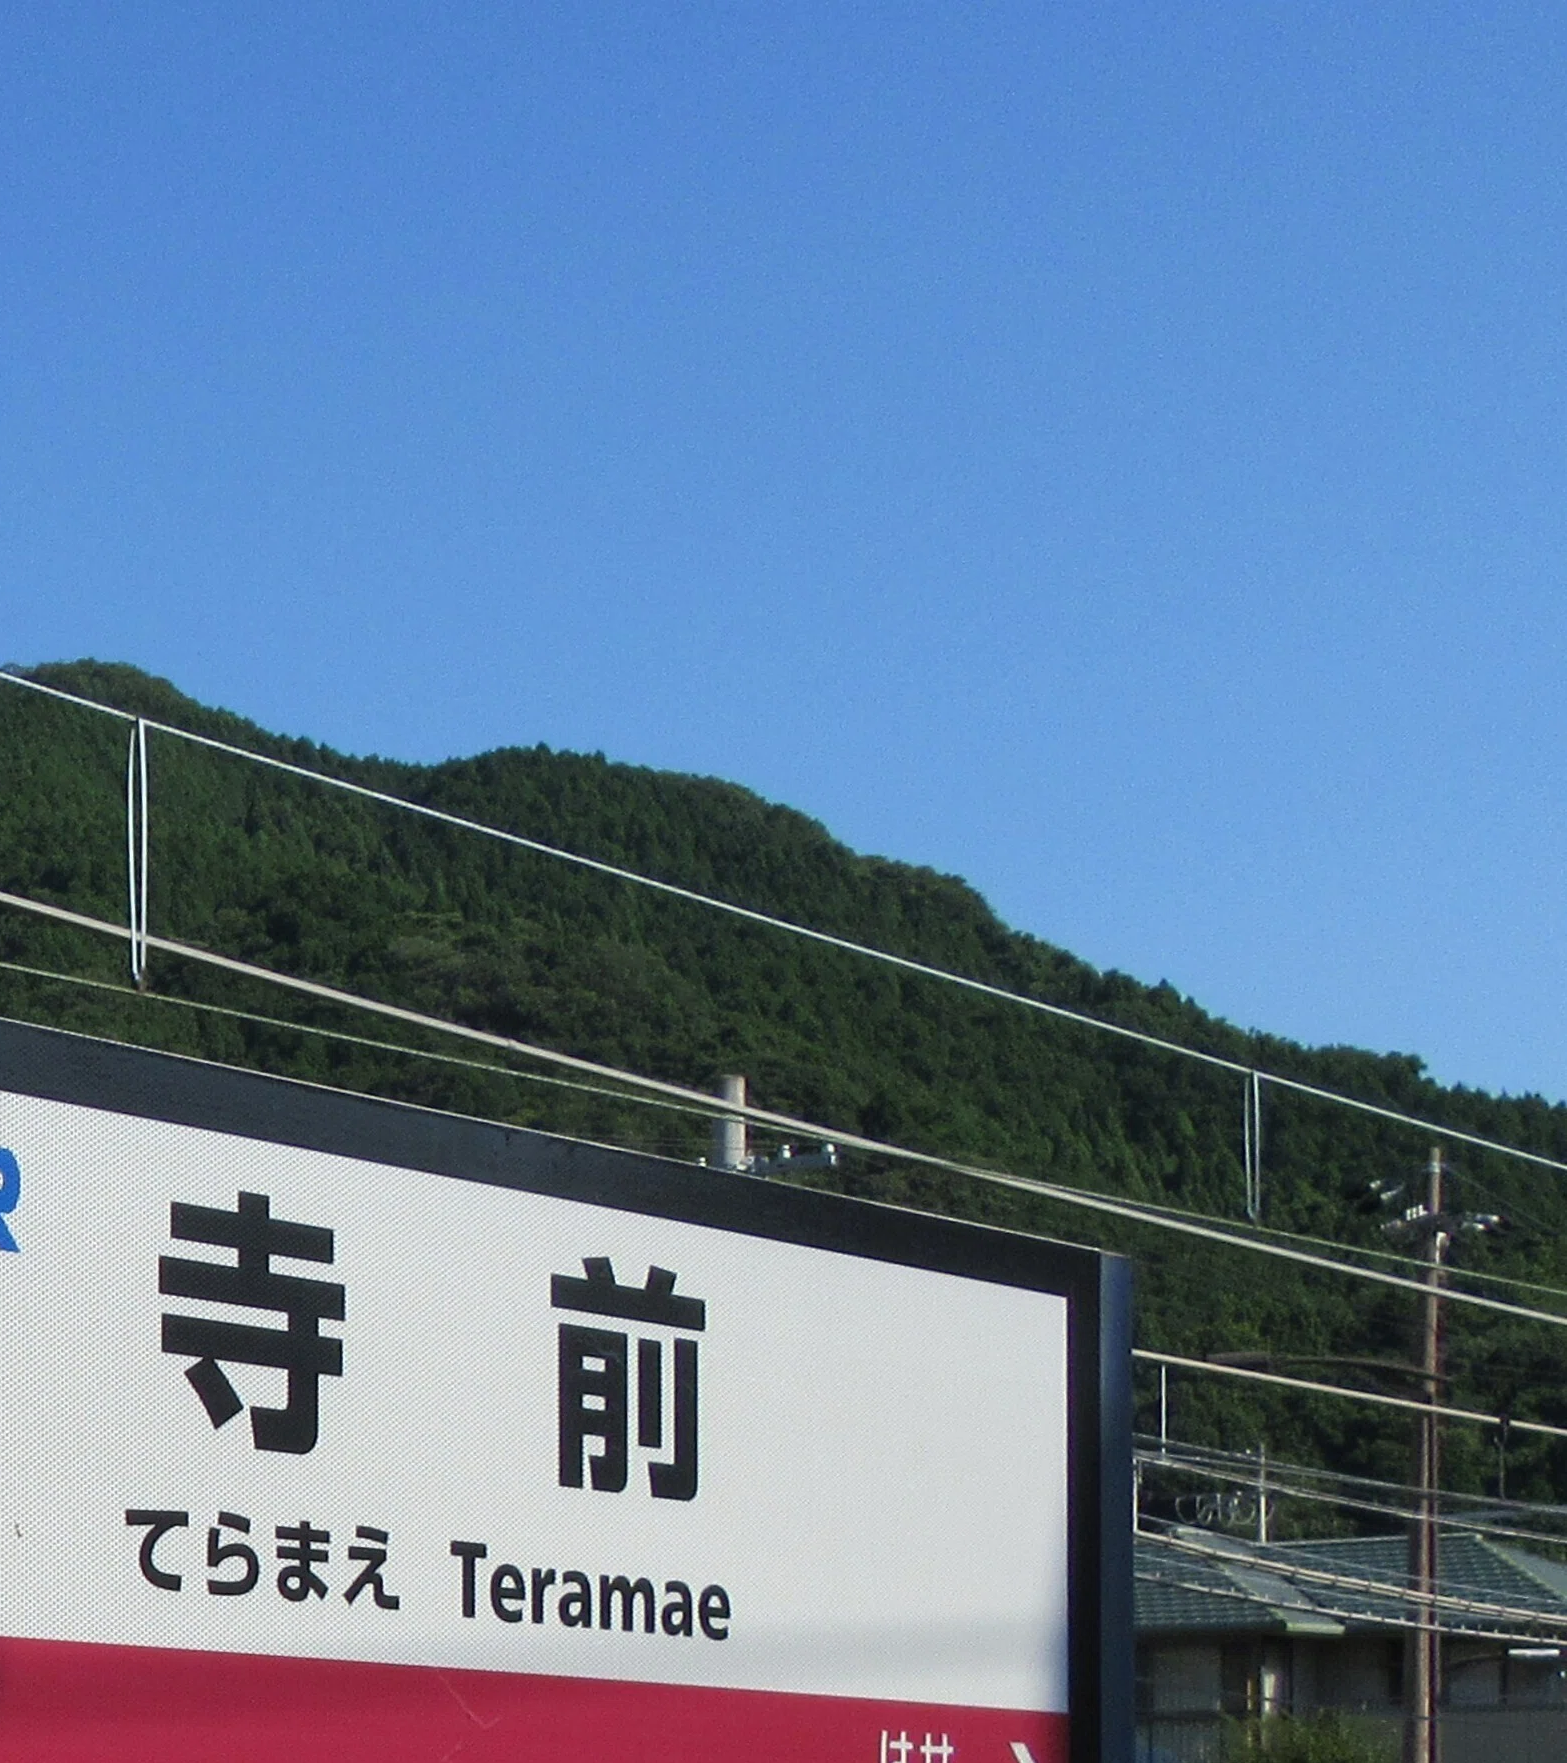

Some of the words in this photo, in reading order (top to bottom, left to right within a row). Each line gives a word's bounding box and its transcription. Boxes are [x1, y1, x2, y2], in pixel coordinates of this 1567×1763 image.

[157, 1190, 707, 1502] 寺前
[125, 1508, 401, 1612] てらまえ
[450, 1540, 732, 1642] Teramae
